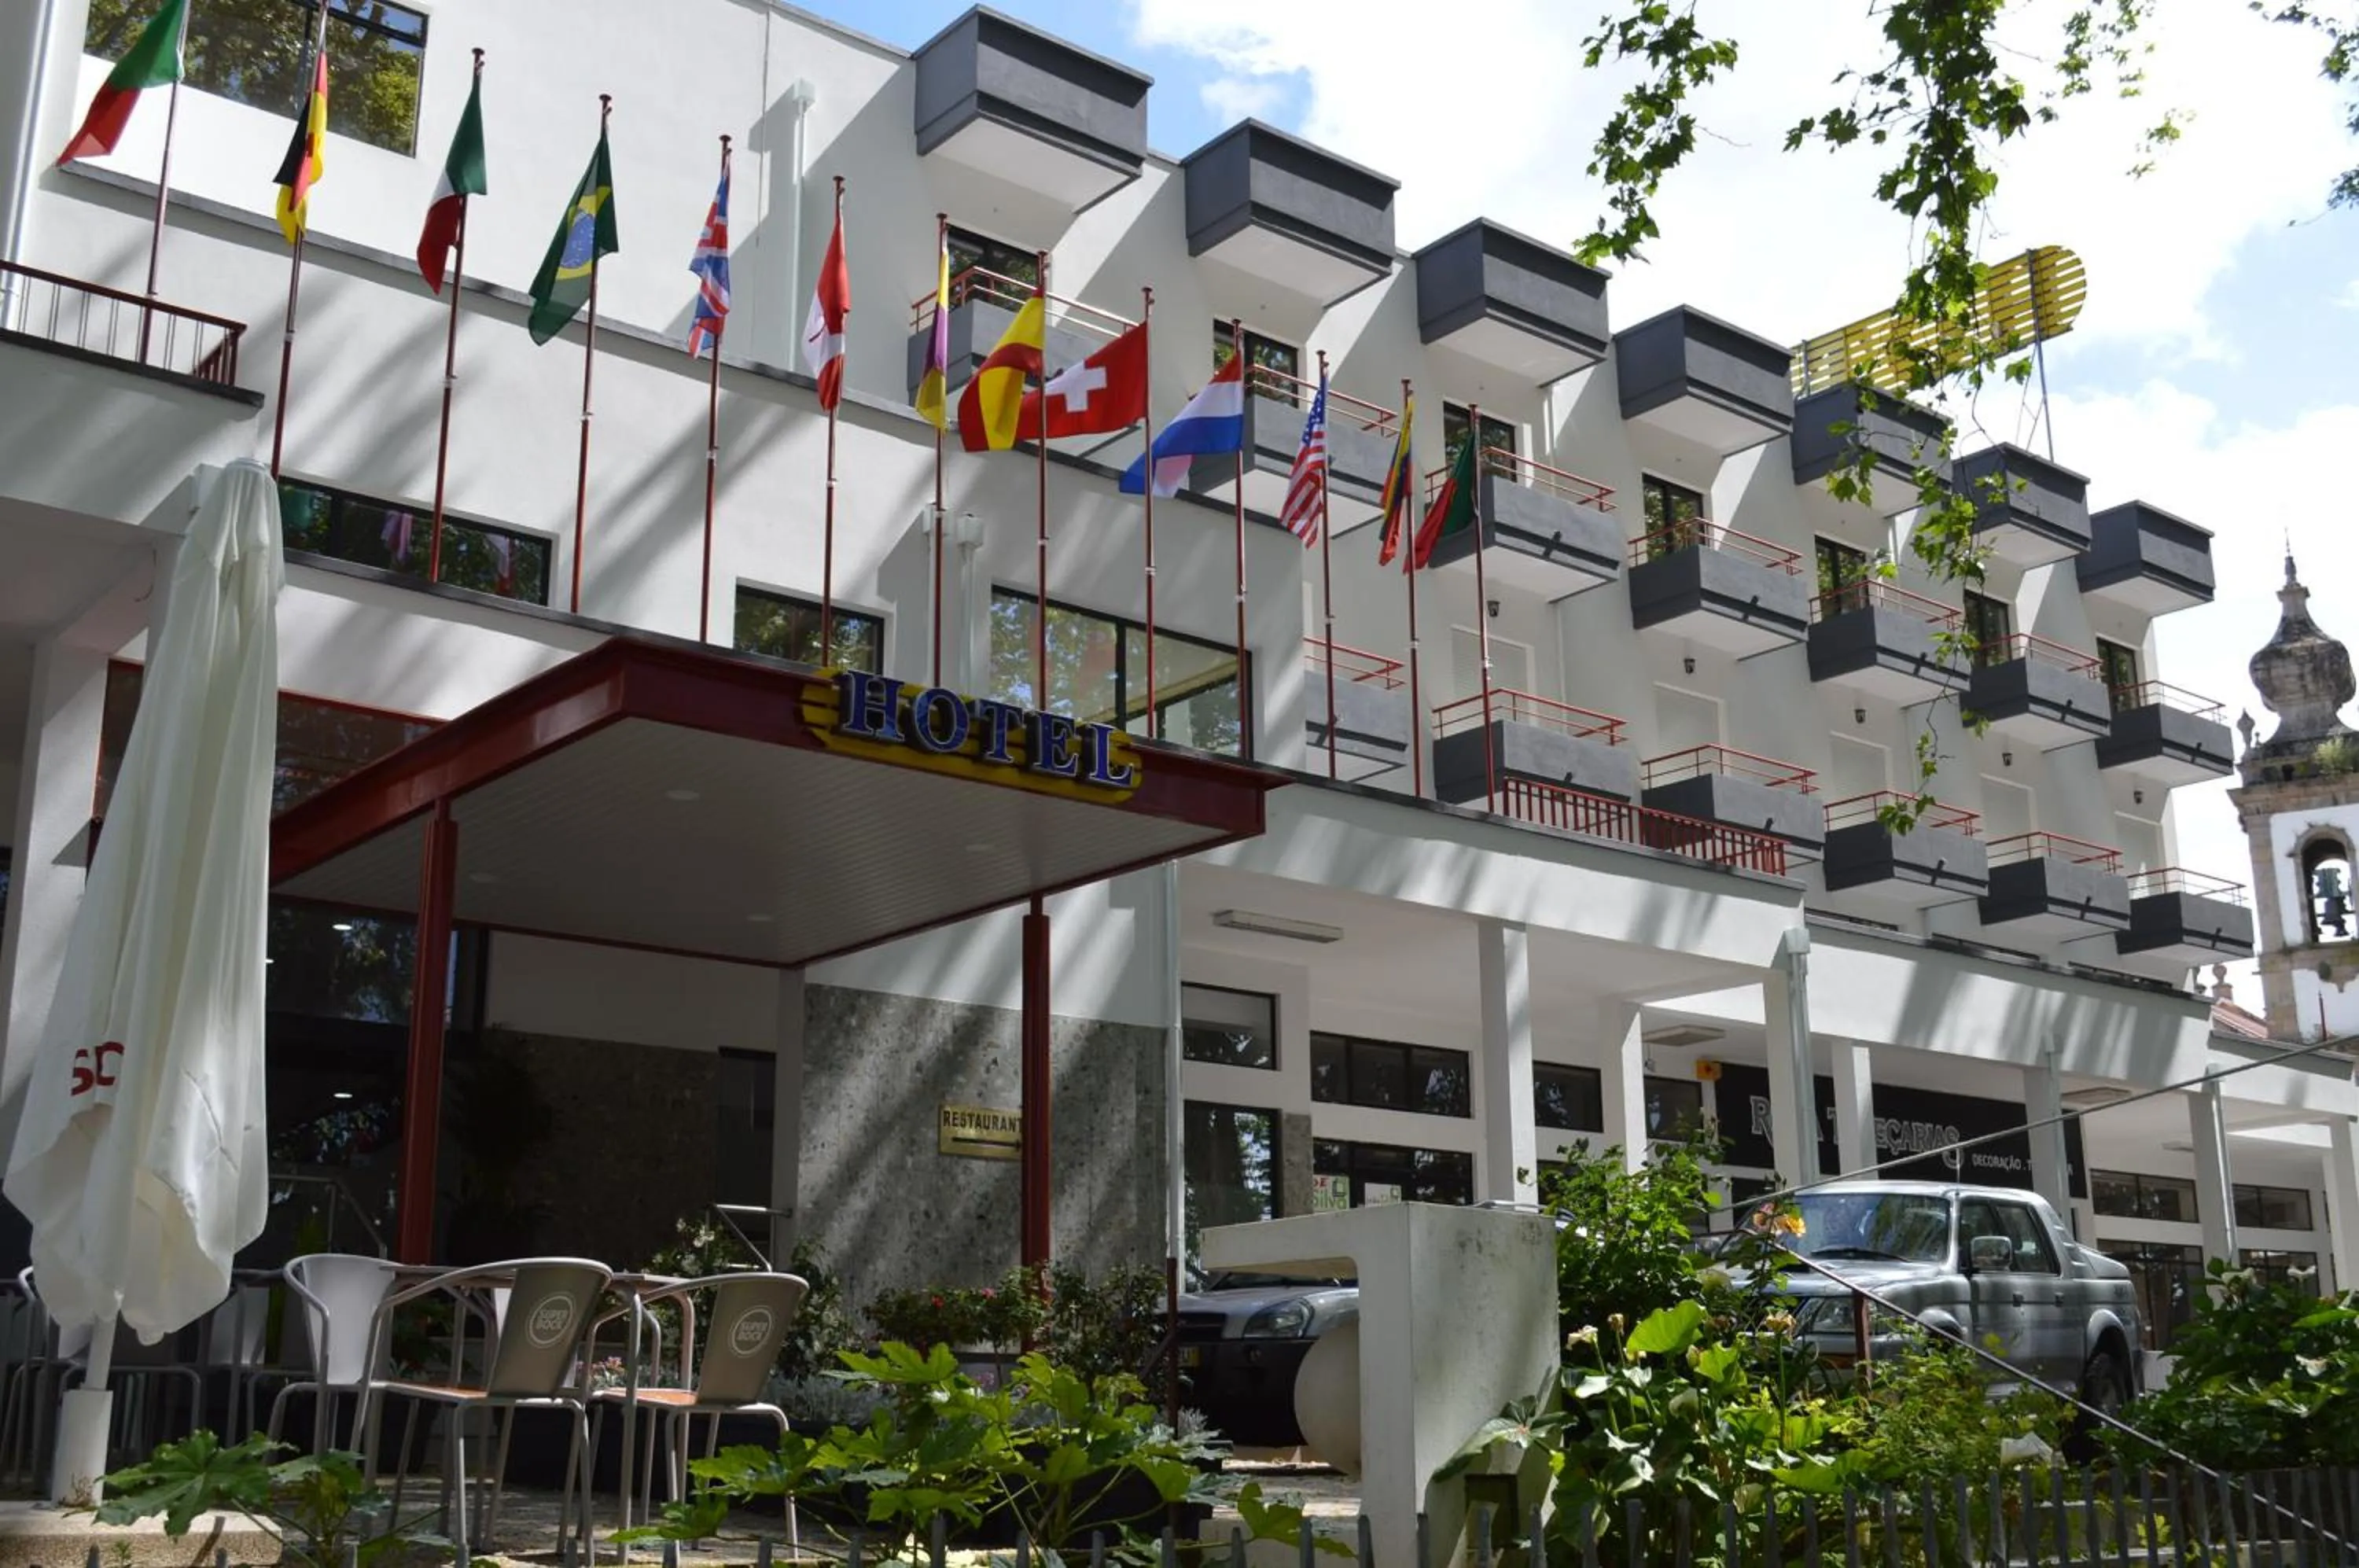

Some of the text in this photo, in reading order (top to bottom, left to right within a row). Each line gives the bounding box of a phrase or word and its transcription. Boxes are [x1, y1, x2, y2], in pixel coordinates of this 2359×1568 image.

[841, 669, 1134, 787] HOTEL
[537, 1309, 569, 1321] SUPER
[740, 1321, 768, 1331] SUPER
[737, 1331, 762, 1341] BOCK
